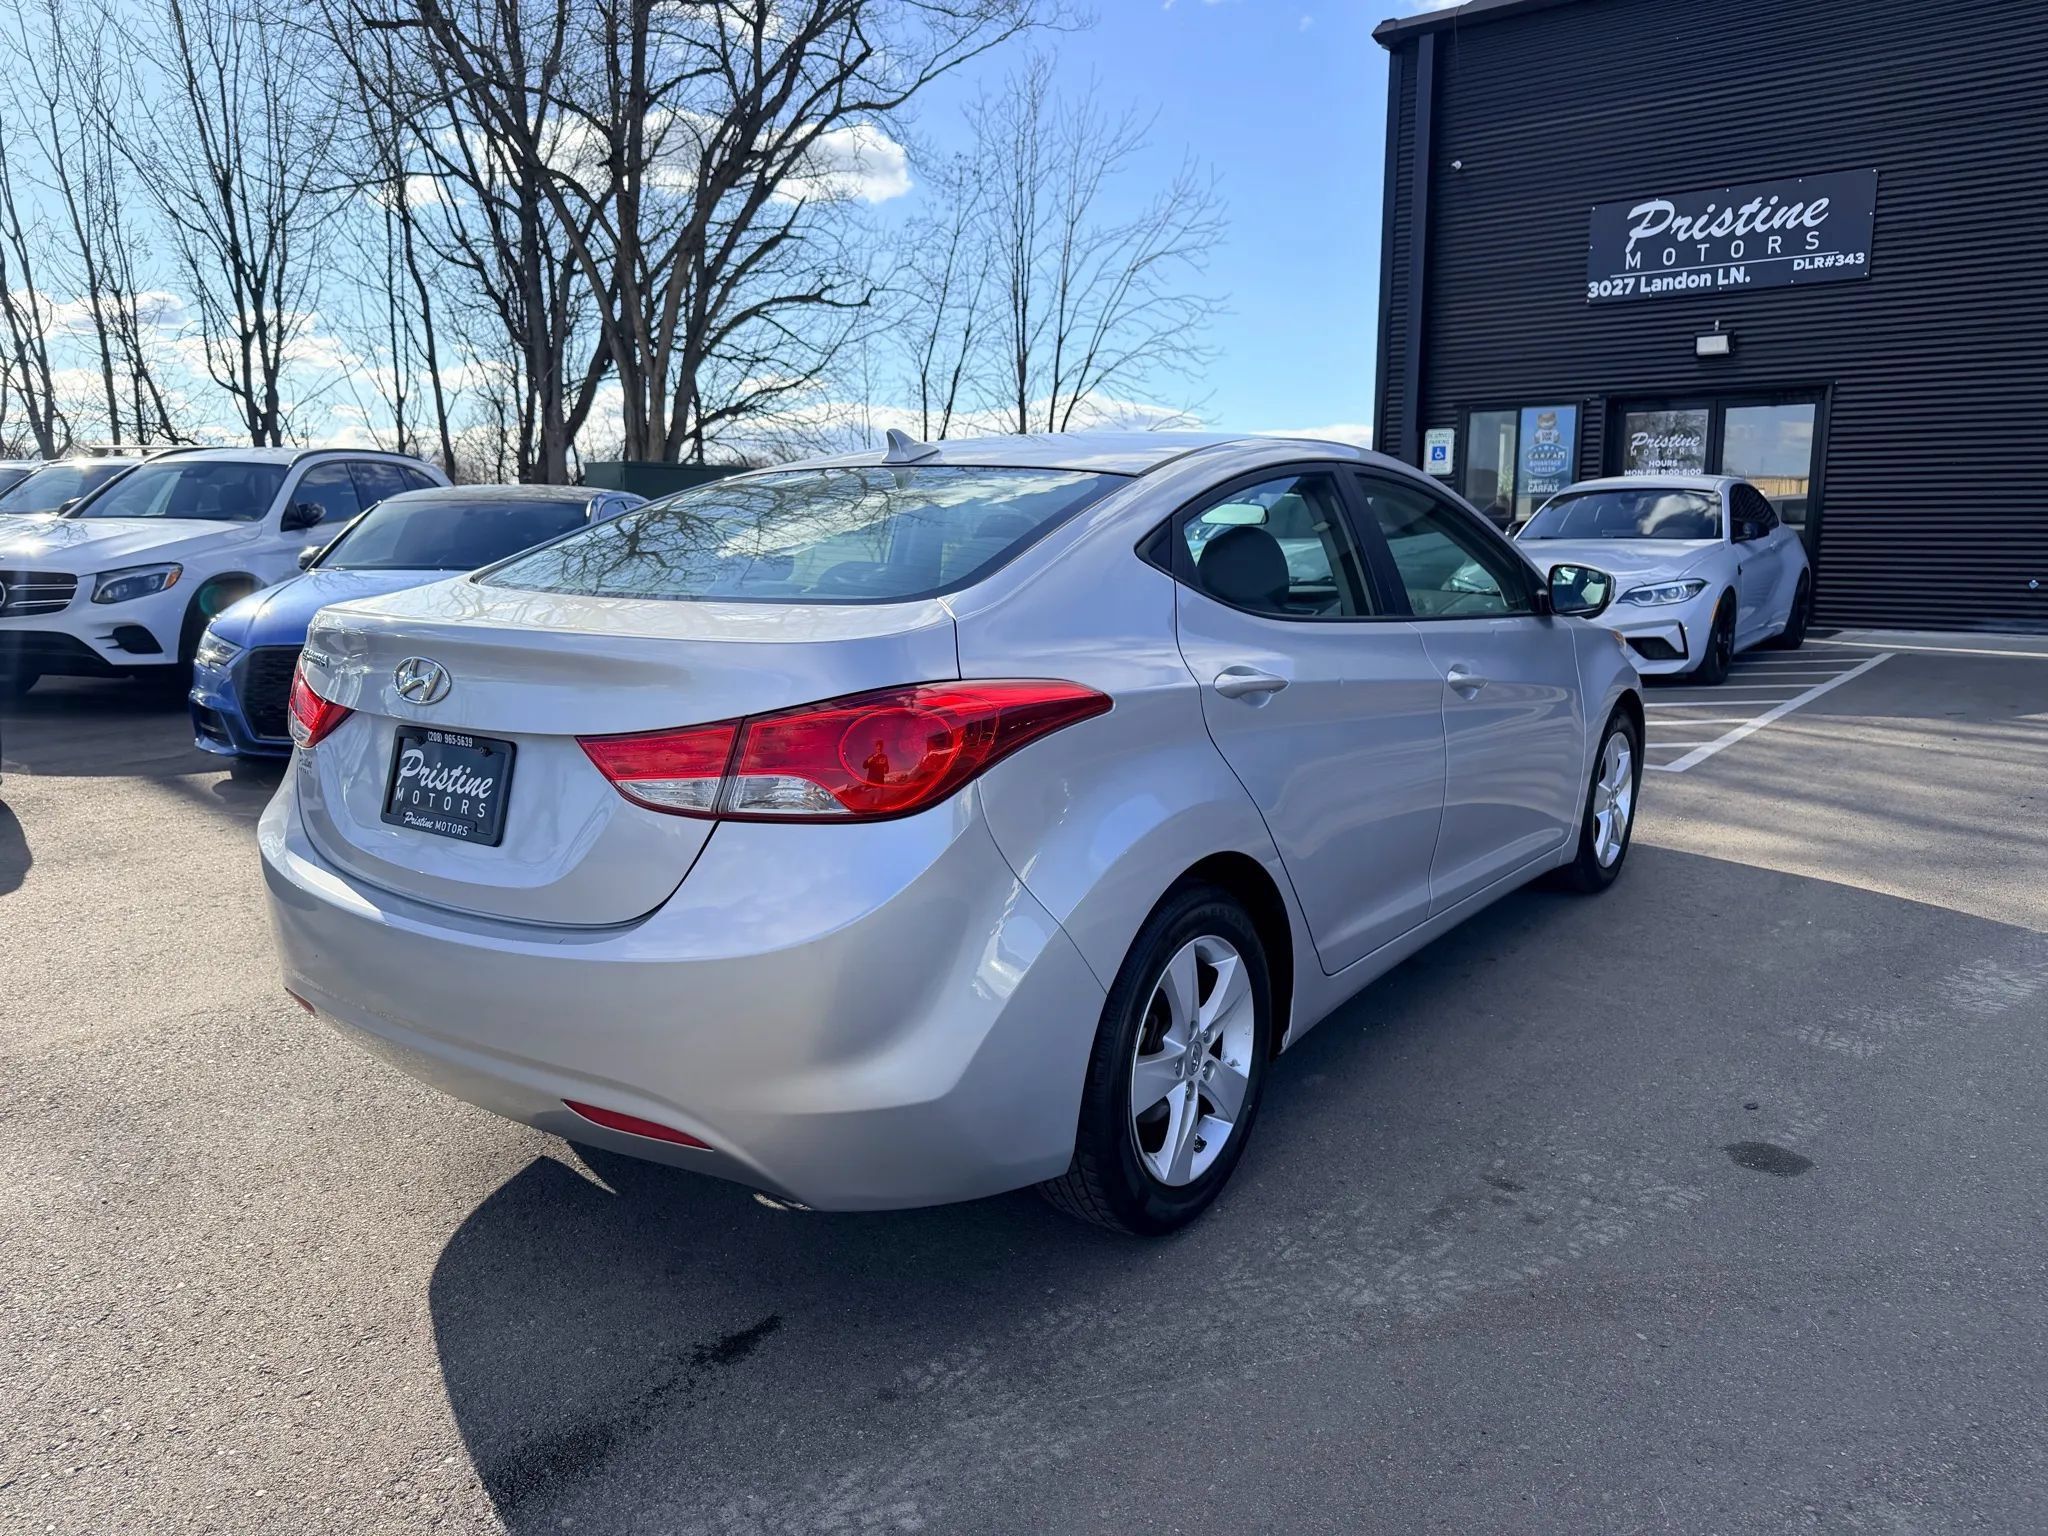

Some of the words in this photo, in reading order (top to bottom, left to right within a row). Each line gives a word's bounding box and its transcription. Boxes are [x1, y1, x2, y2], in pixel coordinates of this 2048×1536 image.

[1625, 195, 1830, 253] Pristine
[1625, 231, 1820, 270] MOTORS
[1793, 252, 1865, 271] DLR#343
[1587, 276, 1635, 299] 3027
[1640, 270, 1712, 294] Landon
[1717, 266, 1751, 286] LN.
[1630, 431, 1701, 450] Pristine
[1630, 446, 1697, 457] MOTORS
[1648, 459, 1678, 468] HOURS
[1527, 483, 1559, 494] CARFAX
[427, 731, 443, 743] (208)
[444, 733, 473, 748] 965-5639
[397, 749, 494, 799] Pristine
[395, 786, 486, 818] MOTORS
[404, 811, 434, 829] Pristine
[434, 820, 468, 836] MOTORS
